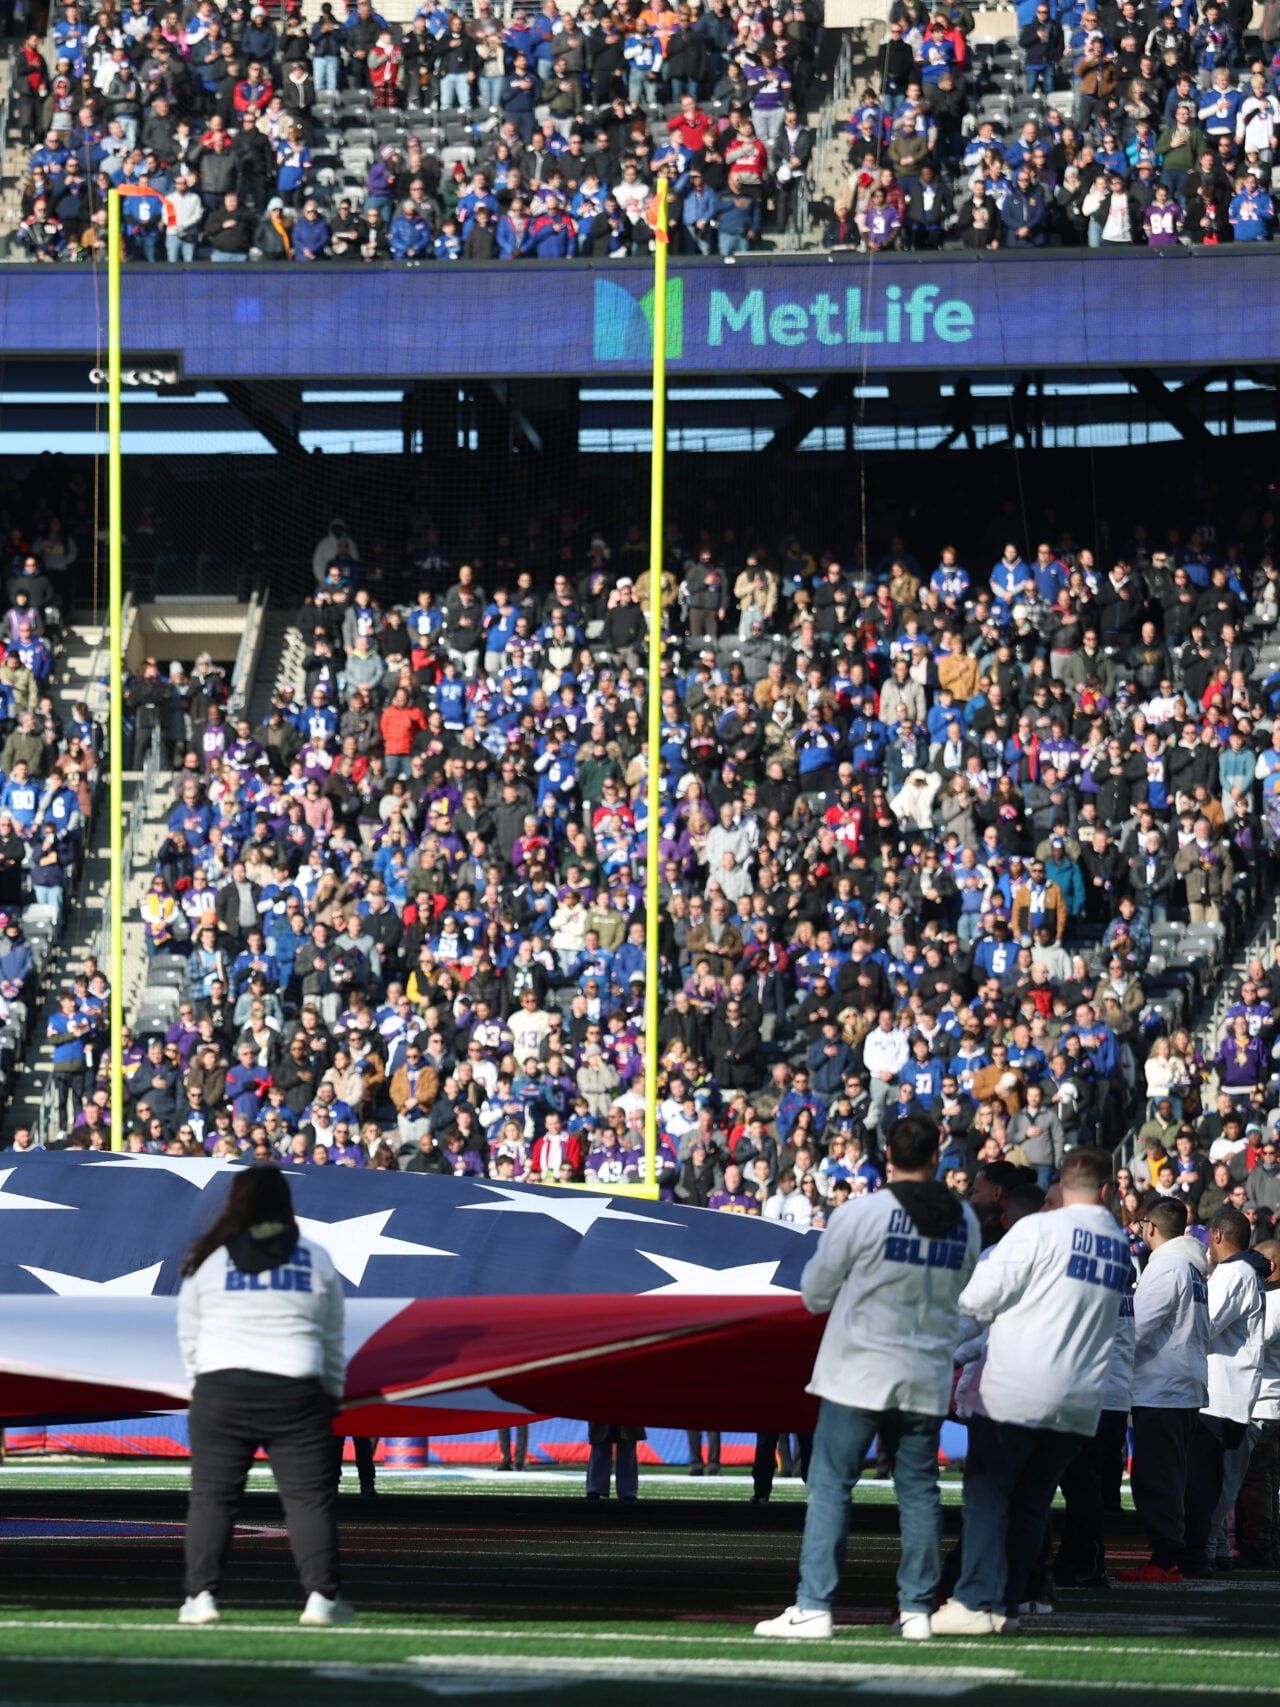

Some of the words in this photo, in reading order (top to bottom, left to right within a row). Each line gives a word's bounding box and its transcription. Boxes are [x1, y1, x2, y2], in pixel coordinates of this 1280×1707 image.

[1150, 212, 1174, 235] 84
[706, 283, 976, 347] MetLife
[991, 949, 1008, 974] 5
[517, 1030, 538, 1049] 43
[916, 1072, 932, 1094] 37
[884, 1236, 967, 1271] BLUE
[224, 1268, 313, 1293] BLUE
